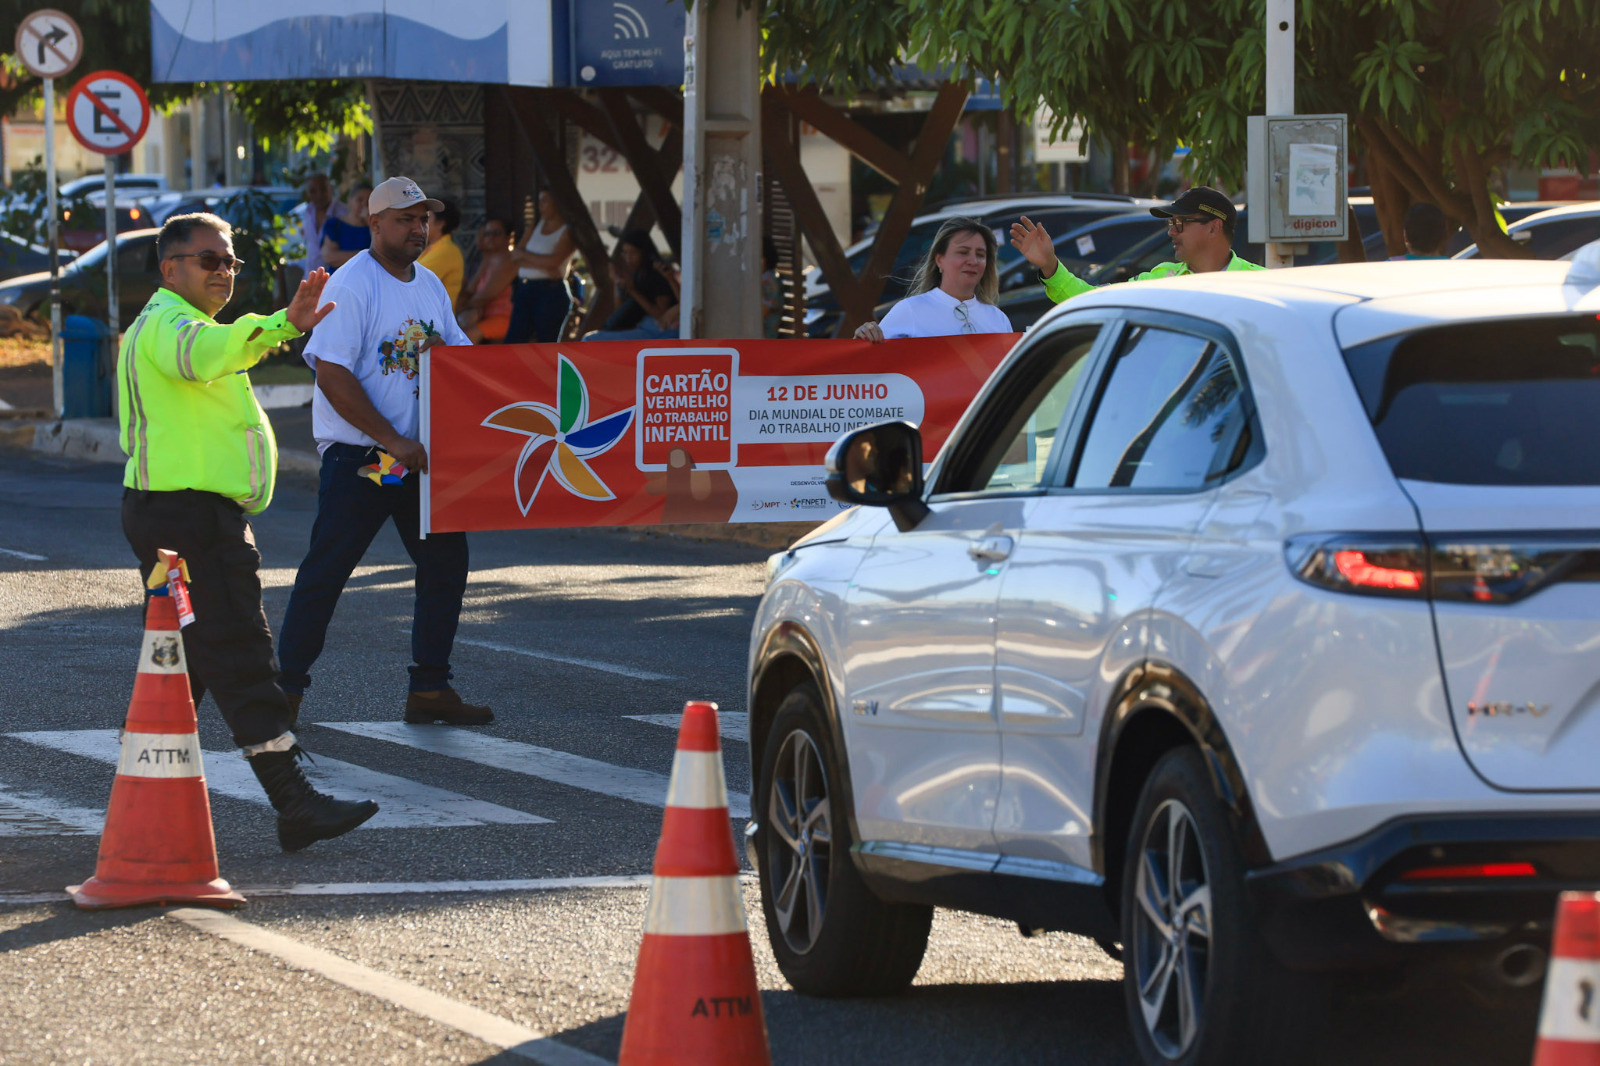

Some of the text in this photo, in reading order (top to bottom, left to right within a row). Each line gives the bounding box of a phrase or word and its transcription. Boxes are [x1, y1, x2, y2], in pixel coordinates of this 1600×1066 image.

[623, 49, 641, 57] TEM
[612, 60, 654, 69] GRATUITO
[93, 91, 121, 134] E
[1293, 218, 1337, 231] digicon
[645, 368, 729, 394] CARTÃO
[767, 383, 888, 402] 12 DE JUNHO
[645, 394, 729, 409] VERMELHO
[645, 411, 728, 424] AO TRABALHO
[749, 406, 904, 421] DIA MUNDIAL DE COMBATE
[645, 424, 729, 443] INFANTIL
[759, 423, 776, 434] AO
[778, 422, 841, 434] TRABALHO
[137, 748, 190, 764] ATTM
[691, 995, 753, 1018] ATTM
